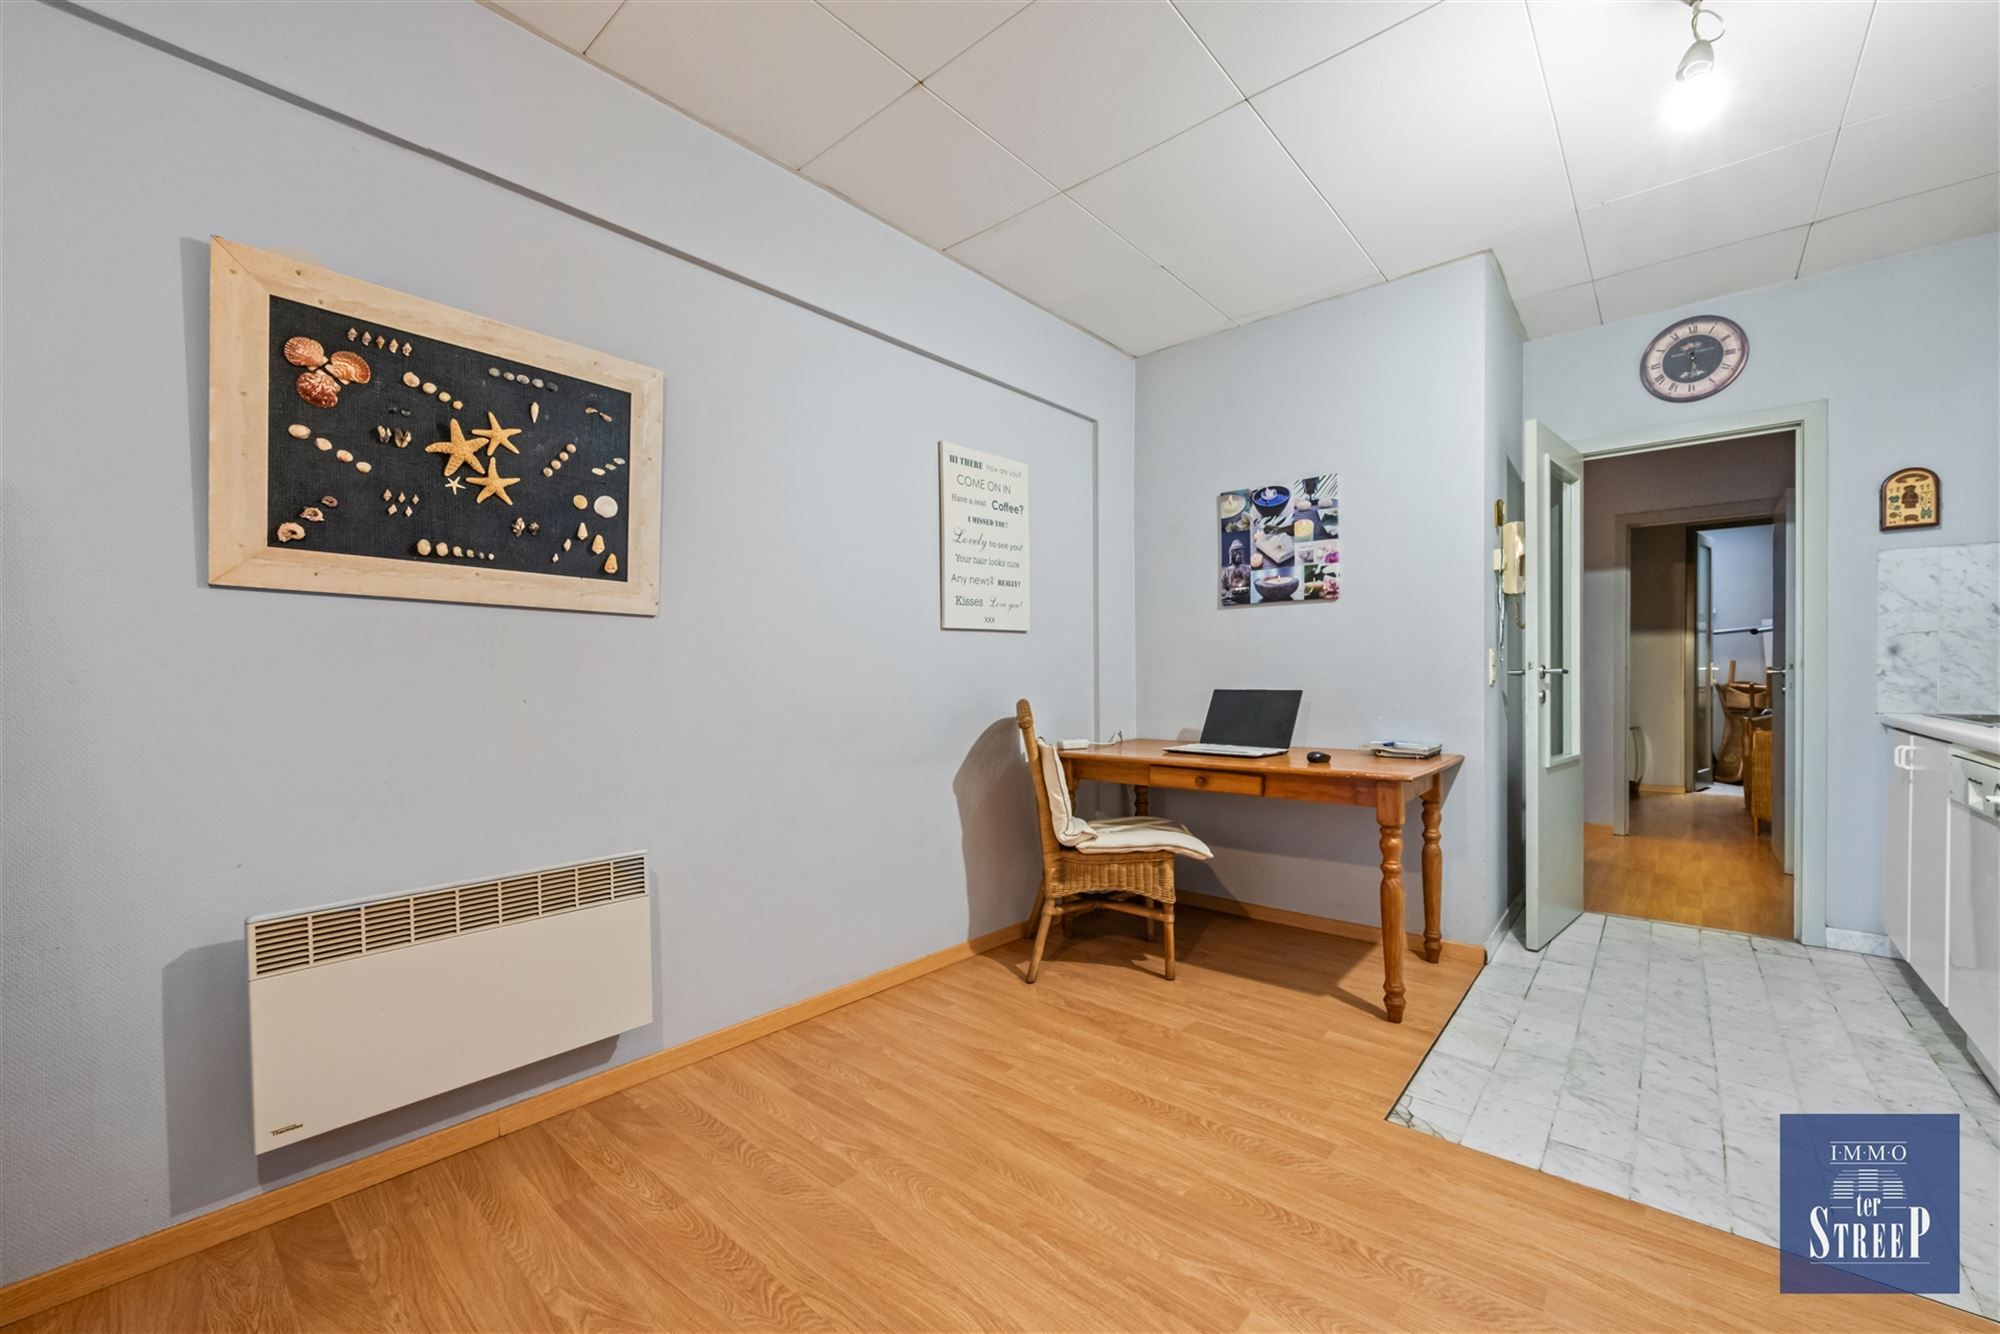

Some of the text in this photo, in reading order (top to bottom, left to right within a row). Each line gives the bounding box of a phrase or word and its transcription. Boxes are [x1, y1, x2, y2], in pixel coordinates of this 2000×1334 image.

[949, 454, 958, 464] HI
[960, 457, 983, 470] THERE
[956, 474, 1011, 495] COME ON IN
[952, 493, 968, 503] Have
[992, 500, 1024, 515] Coffee?
[972, 516, 994, 527] MISSED
[953, 526, 988, 552] Lovely
[955, 553, 972, 563] Your
[973, 556, 987, 565] hair
[989, 557, 1006, 567] looks
[951, 573, 967, 586] Any
[969, 576, 994, 586] news?
[955, 595, 983, 607] Kisses
